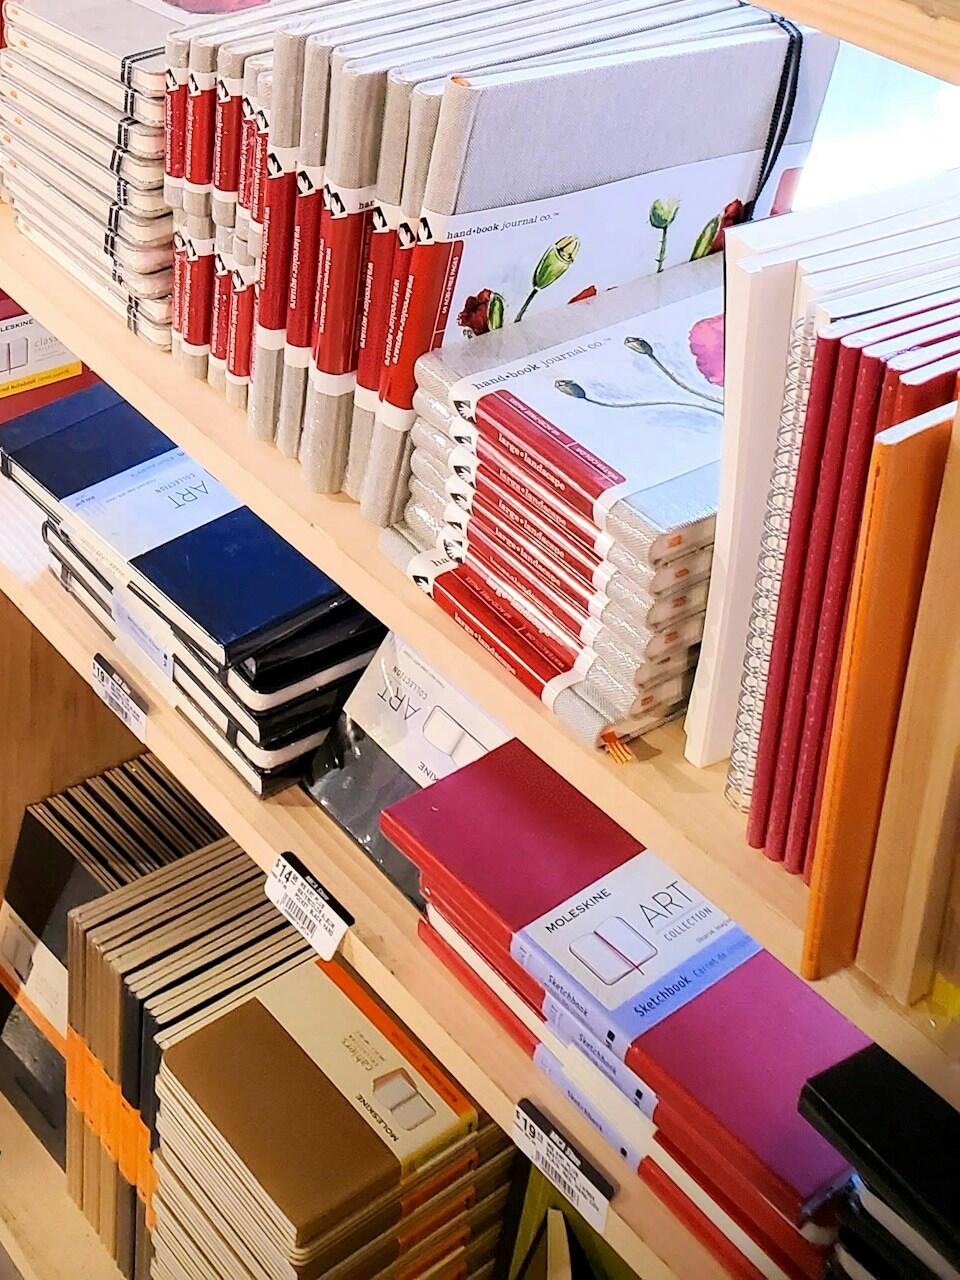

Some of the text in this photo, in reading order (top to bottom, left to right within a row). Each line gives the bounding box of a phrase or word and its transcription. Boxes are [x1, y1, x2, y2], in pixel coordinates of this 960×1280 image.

[500, 217, 538, 232] journal
[443, 256, 459, 308] ACID-FREE PAGES
[541, 344, 586, 369] journal
[10, 378, 36, 389] Notebook
[155, 472, 196, 495] COLLECTION
[167, 480, 209, 510] ART
[393, 665, 429, 701] COLLECTION
[377, 687, 421, 720] ART
[545, 887, 612, 935] MOLESKINE
[638, 880, 693, 929] ART
[663, 906, 714, 942] COLLECTION
[547, 973, 590, 1018] Sketchbook
[634, 974, 693, 1018] Sketchbook
[578, 1032, 618, 1077] Sketchbook
[357, 1093, 400, 1142] MOLESKINE
